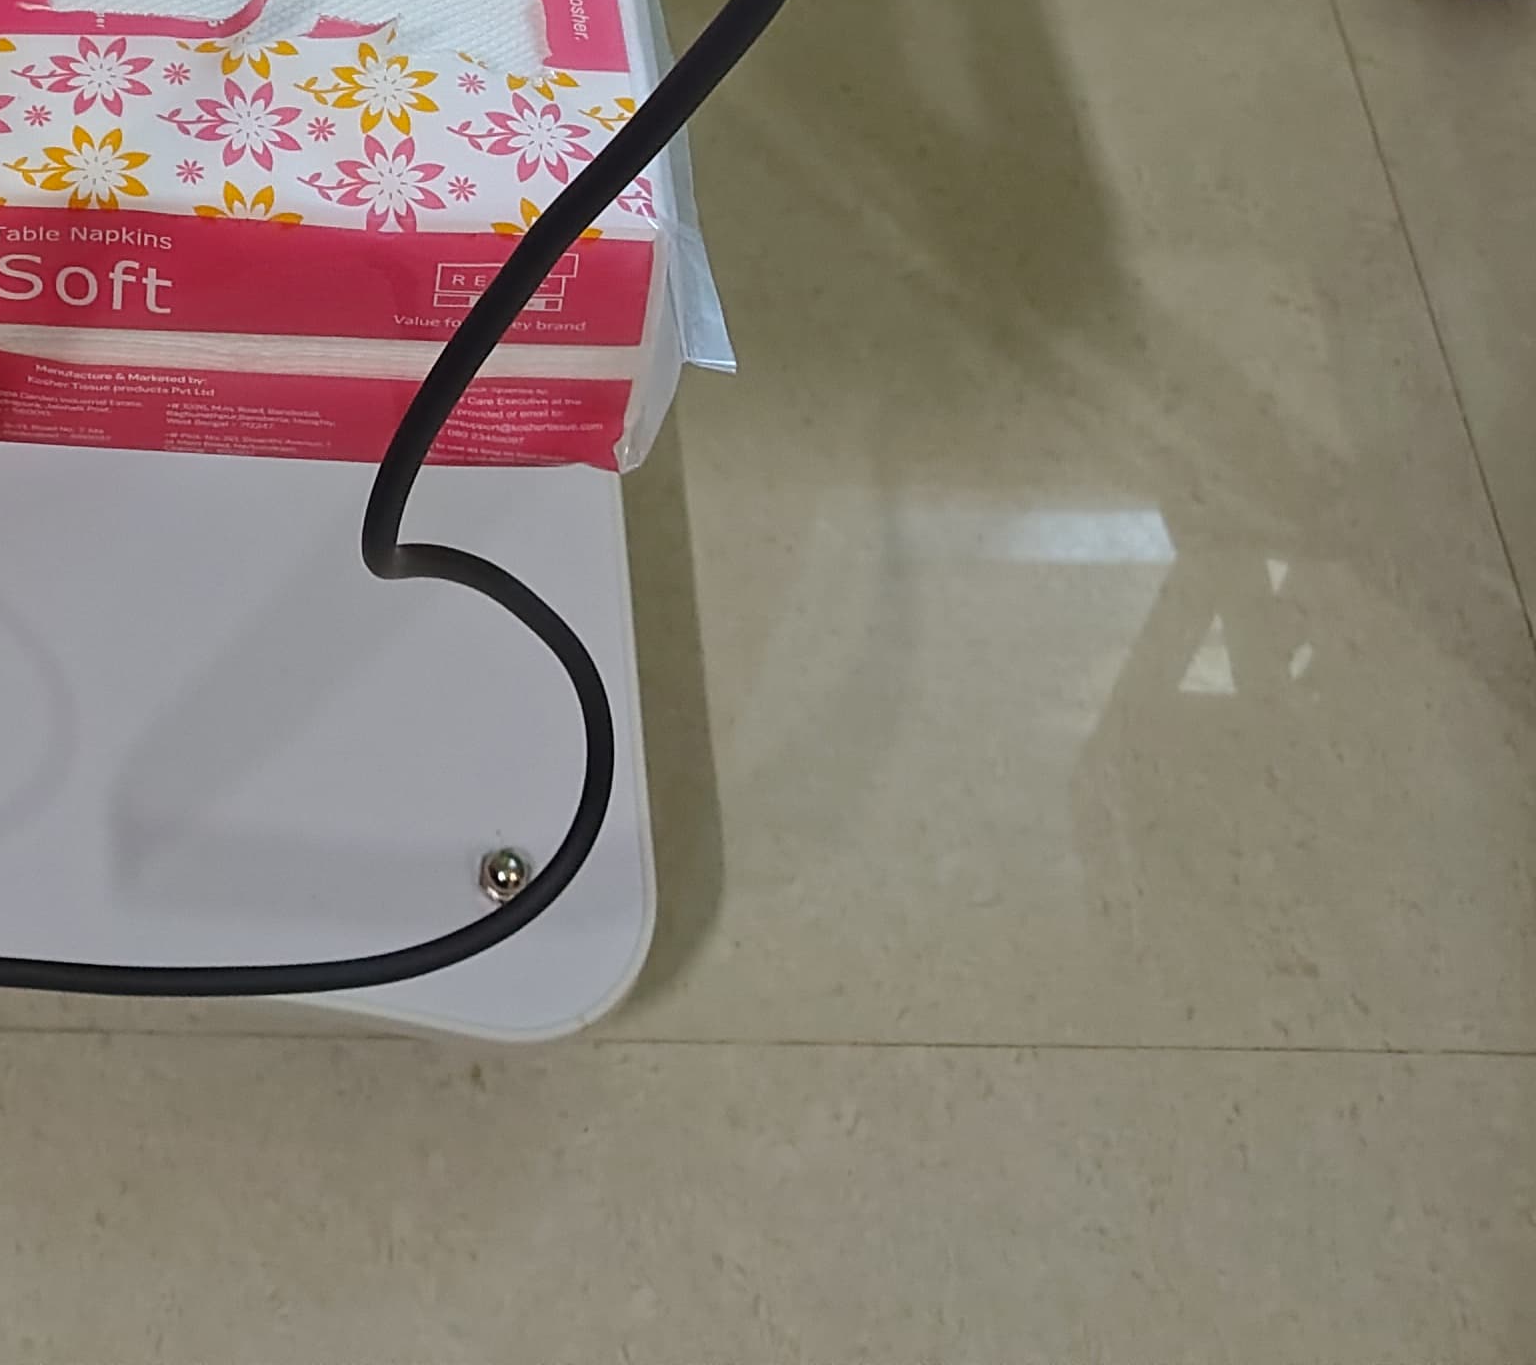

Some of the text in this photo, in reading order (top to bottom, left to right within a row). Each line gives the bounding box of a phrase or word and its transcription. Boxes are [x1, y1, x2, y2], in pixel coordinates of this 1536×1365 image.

[70, 226, 173, 250] Napkins
[393, 314, 443, 328] Value
[445, 315, 462, 328] fo
[536, 320, 586, 331] brand
[35, 364, 112, 381] Manufacture
[27, 375, 215, 397] Kosher Tissue products Pvt Ltd
